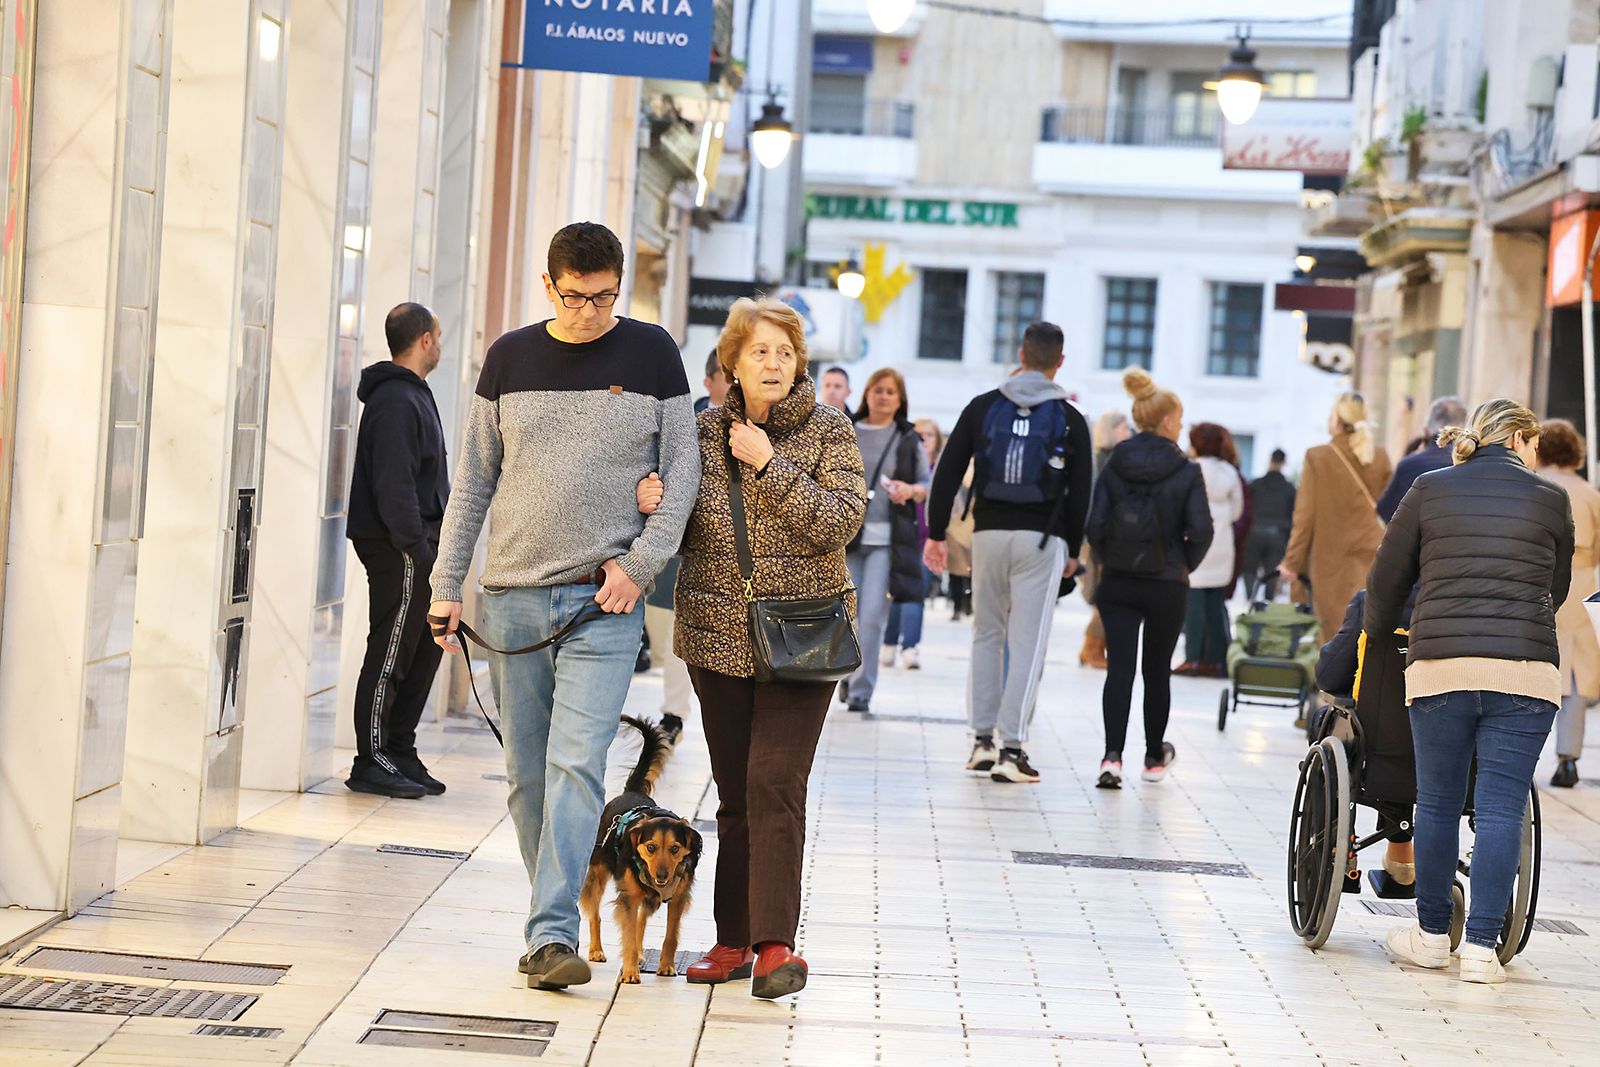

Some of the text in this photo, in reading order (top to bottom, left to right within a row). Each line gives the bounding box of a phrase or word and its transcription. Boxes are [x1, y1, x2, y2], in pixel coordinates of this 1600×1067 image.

[566, 21, 625, 42] ÁBALOS
[633, 30, 688, 46] NUEVO
[904, 199, 956, 224] DEL
[963, 202, 1018, 227] SUR
